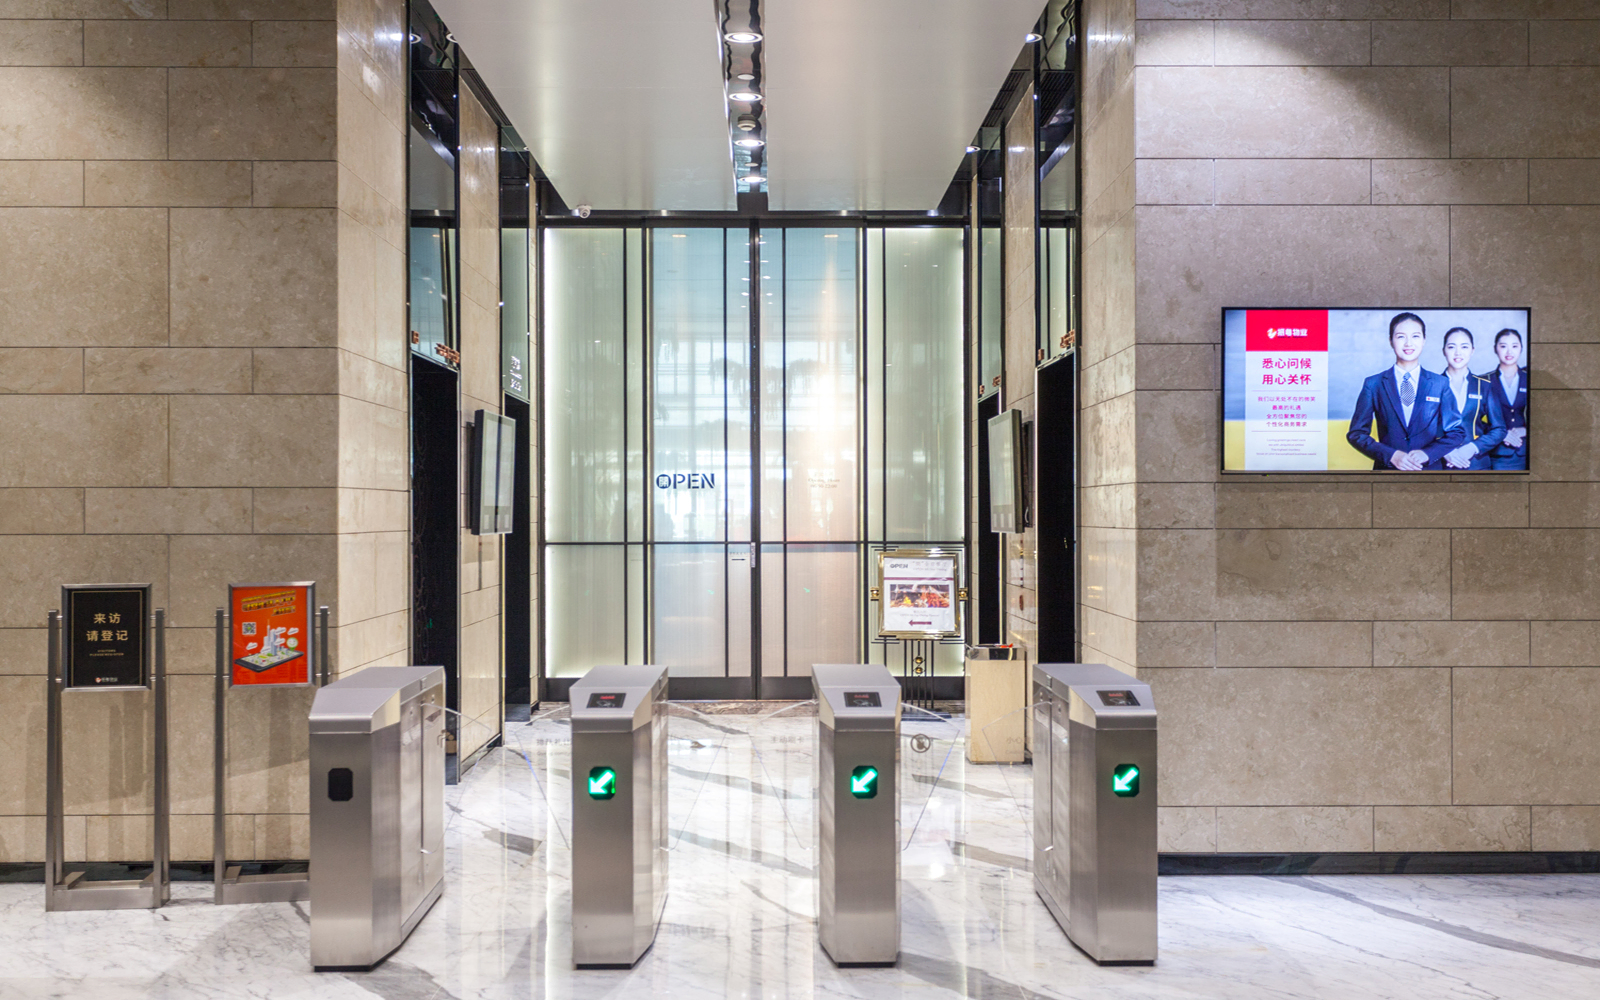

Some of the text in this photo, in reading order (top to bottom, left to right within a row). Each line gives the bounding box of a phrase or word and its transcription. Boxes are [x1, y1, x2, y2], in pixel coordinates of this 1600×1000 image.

[1262, 358, 1312, 369] 悉心问候
[1262, 374, 1312, 385] 用心关怀
[655, 473, 716, 489] OPEN
[93, 612, 122, 624] 来访
[86, 630, 129, 642] 请登记
